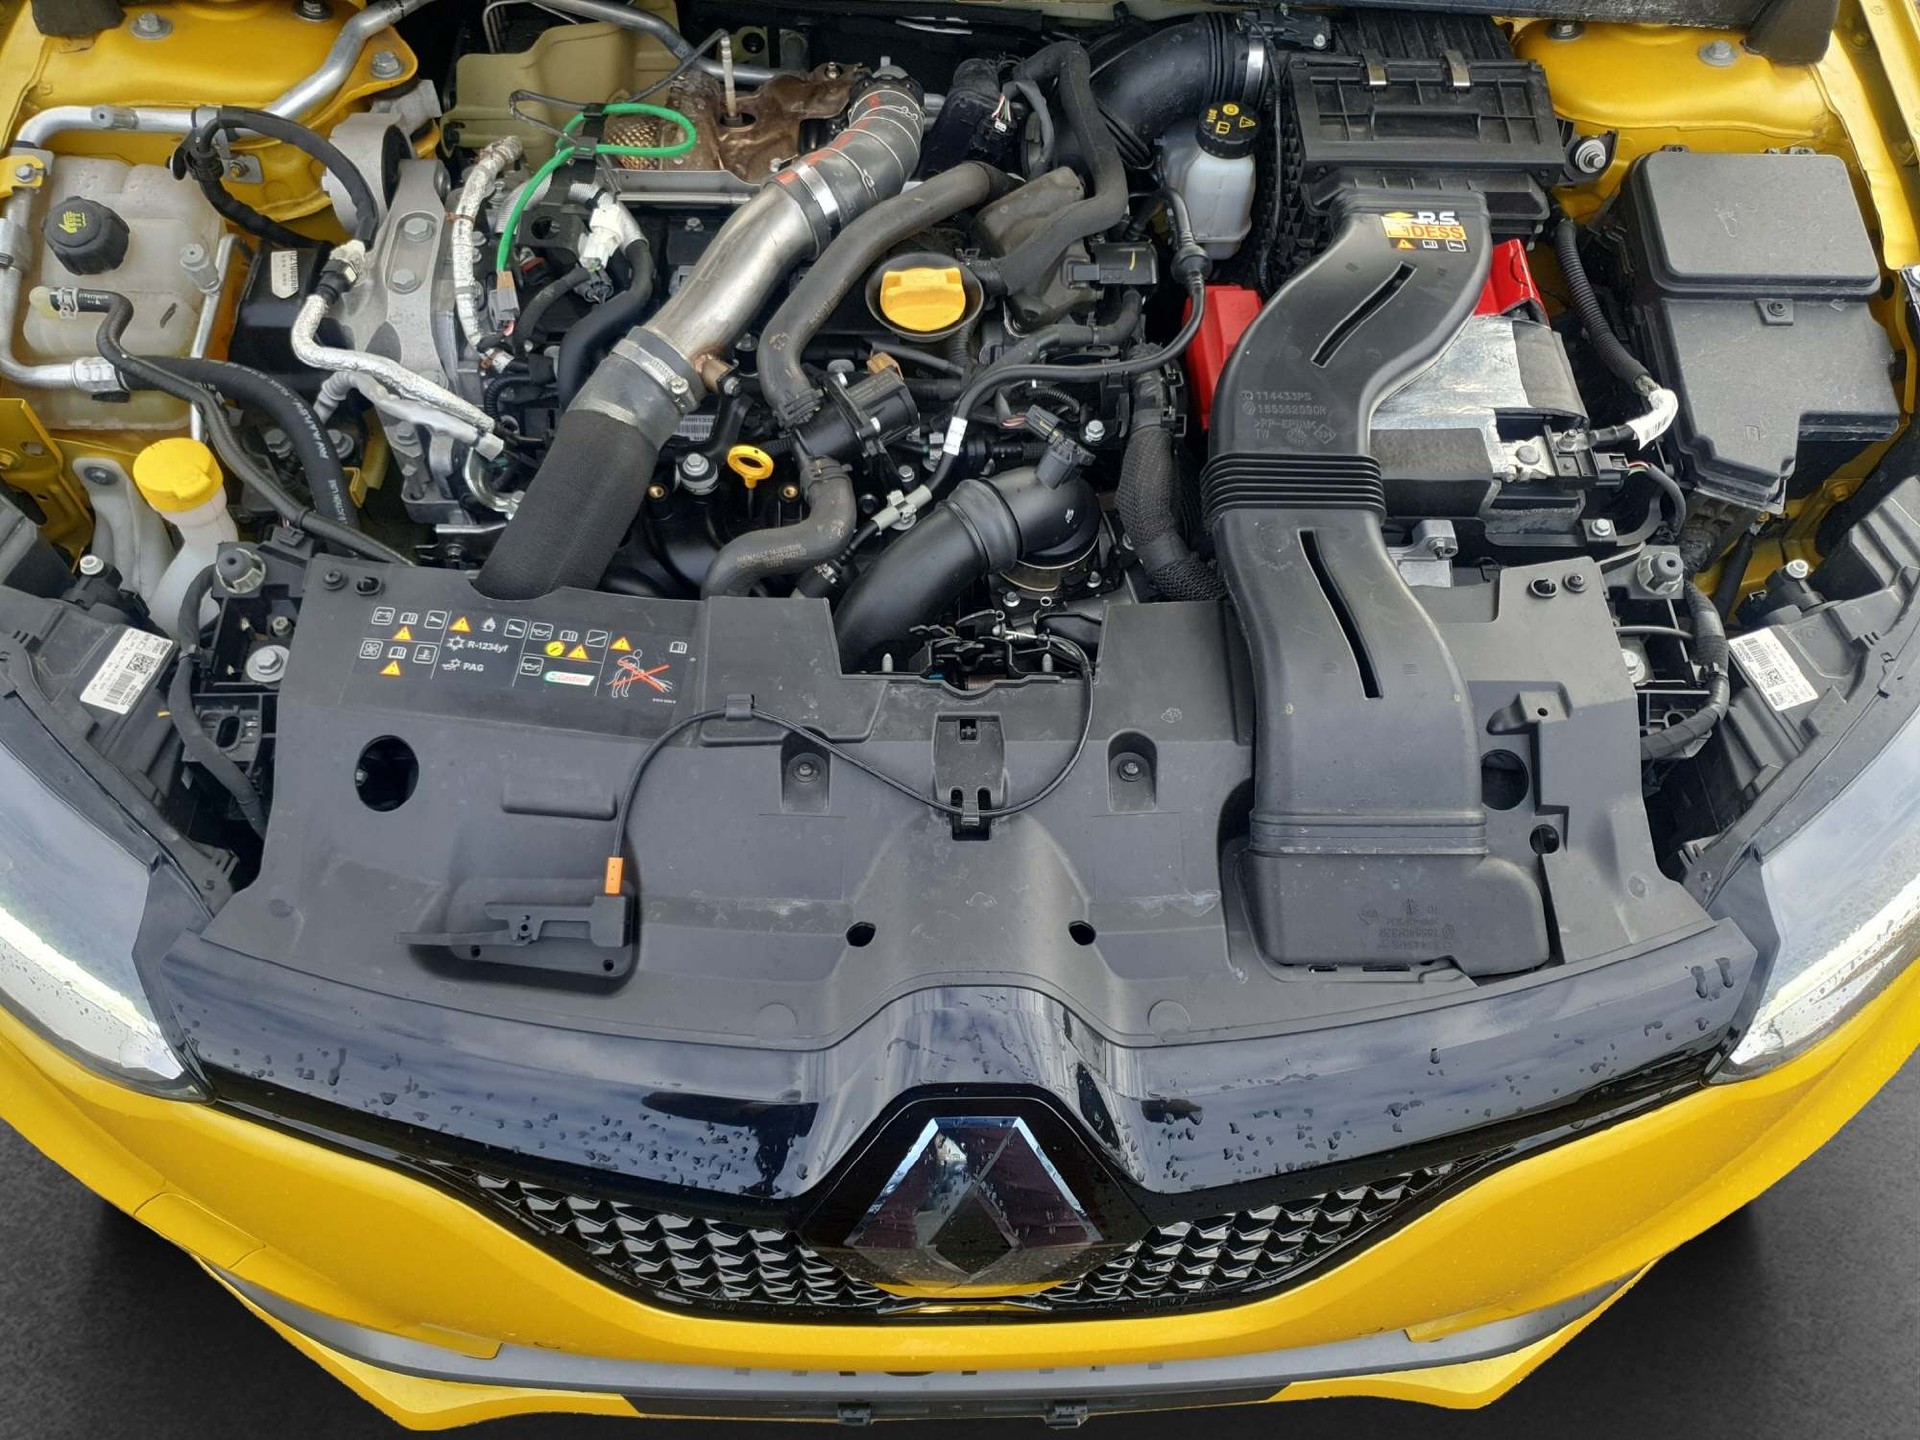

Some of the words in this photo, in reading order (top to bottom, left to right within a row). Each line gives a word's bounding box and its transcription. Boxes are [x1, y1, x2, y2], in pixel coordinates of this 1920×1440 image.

[1411, 225, 1464, 239] DESS
[467, 640, 509, 654] R-1234yf
[463, 662, 484, 672] PAG
